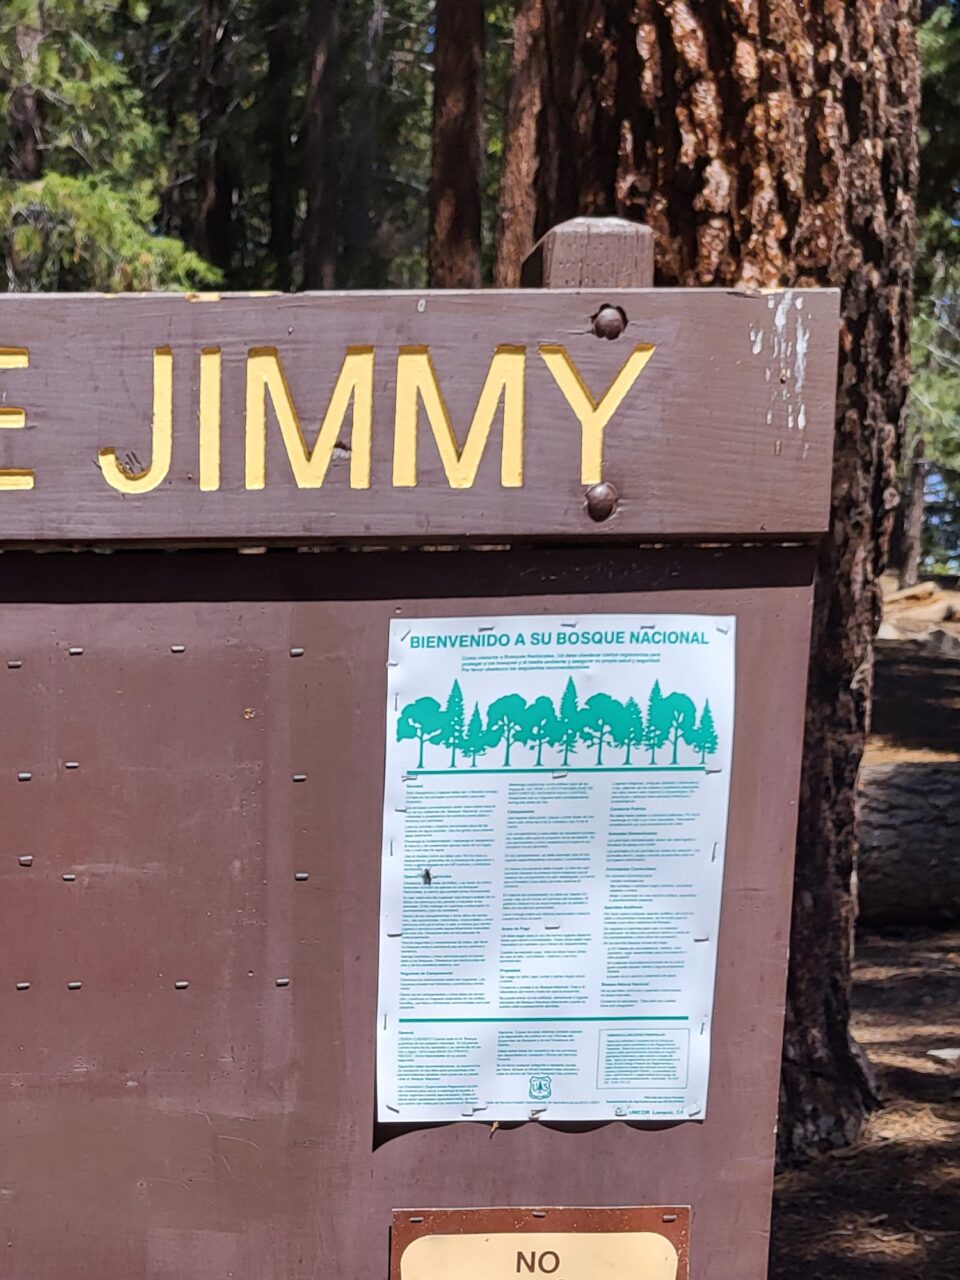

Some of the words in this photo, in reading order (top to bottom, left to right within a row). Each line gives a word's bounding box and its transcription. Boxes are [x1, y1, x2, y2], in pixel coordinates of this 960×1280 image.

[98, 344, 656, 494] JIMMY
[409, 633, 511, 649] BIENVENIDO
[513, 632, 526, 646] A
[530, 631, 552, 646] SU
[557, 631, 625, 646] BOSQUE
[629, 630, 710, 645] NACIONAL
[516, 1250, 560, 1274] NO
